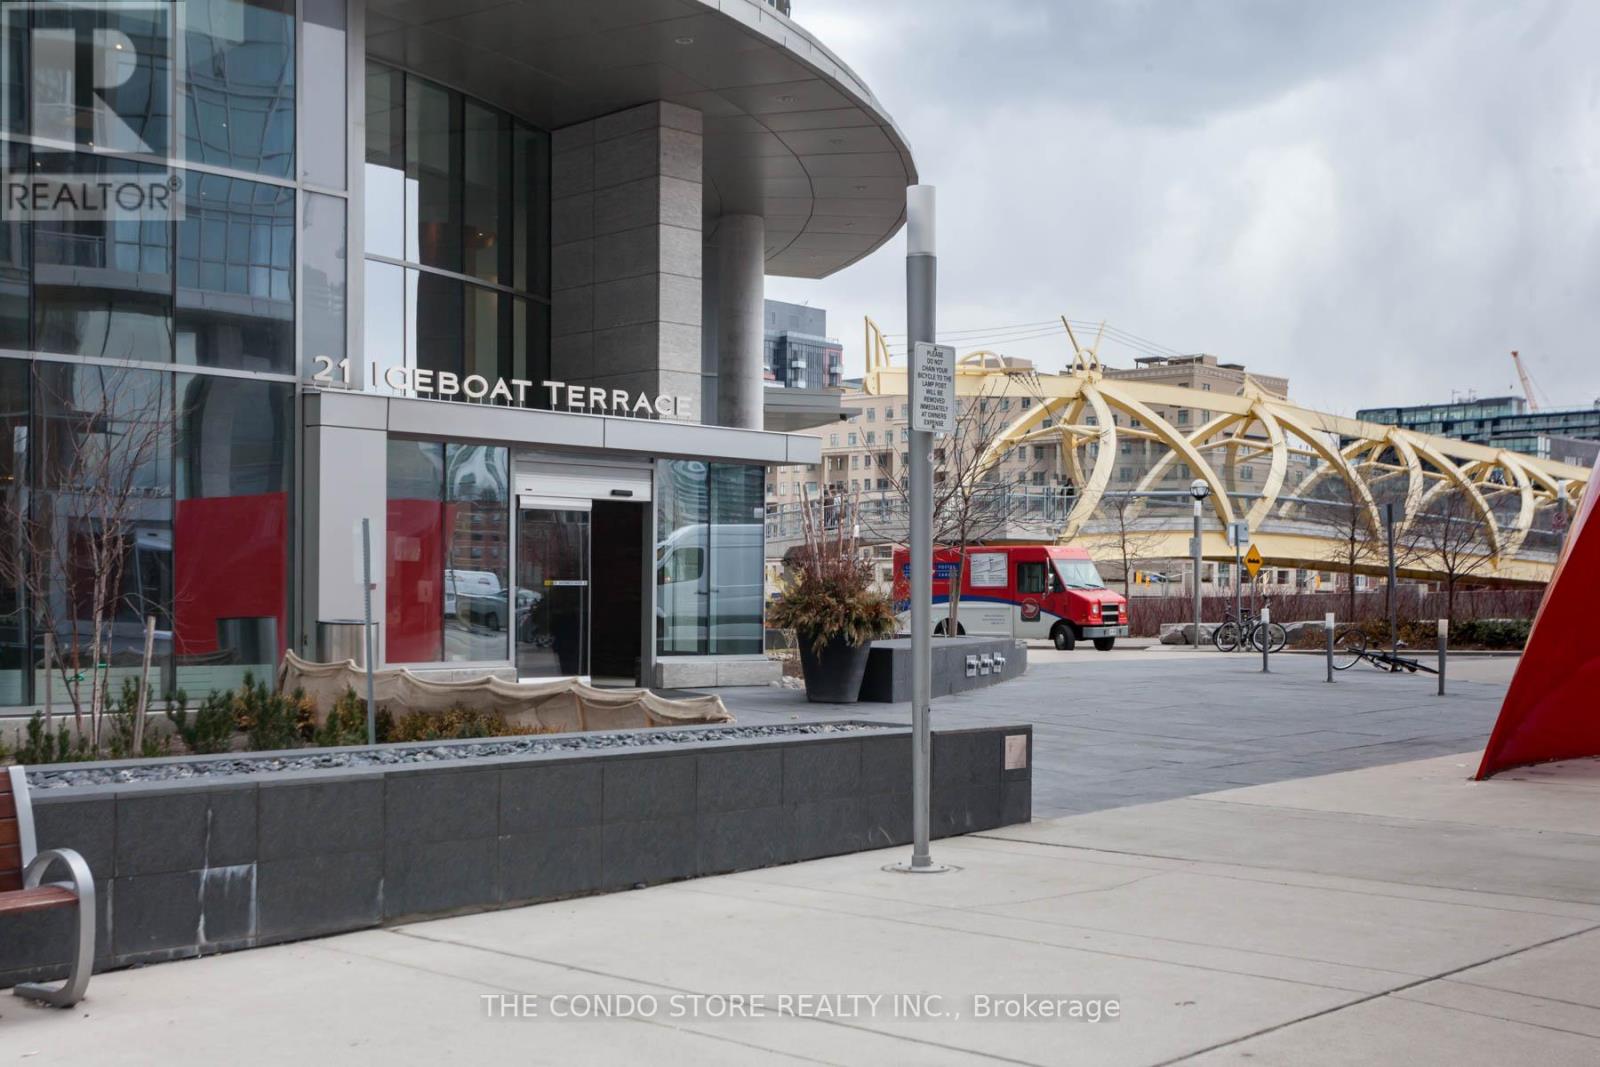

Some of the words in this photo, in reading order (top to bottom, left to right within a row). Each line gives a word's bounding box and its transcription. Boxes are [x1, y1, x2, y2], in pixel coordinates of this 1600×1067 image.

[927, 350, 944, 358] PLEASE
[918, 372, 936, 381] BICYCLE
[944, 375, 952, 383] THE
[313, 355, 351, 384] 21
[372, 361, 532, 400] ICEBOAT
[543, 379, 693, 416] TERRACE
[926, 388, 936, 396] WILL
[924, 396, 945, 404] REMOVED
[920, 403, 948, 412] IMMEDIATELY
[924, 419, 944, 427] EXPENSE
